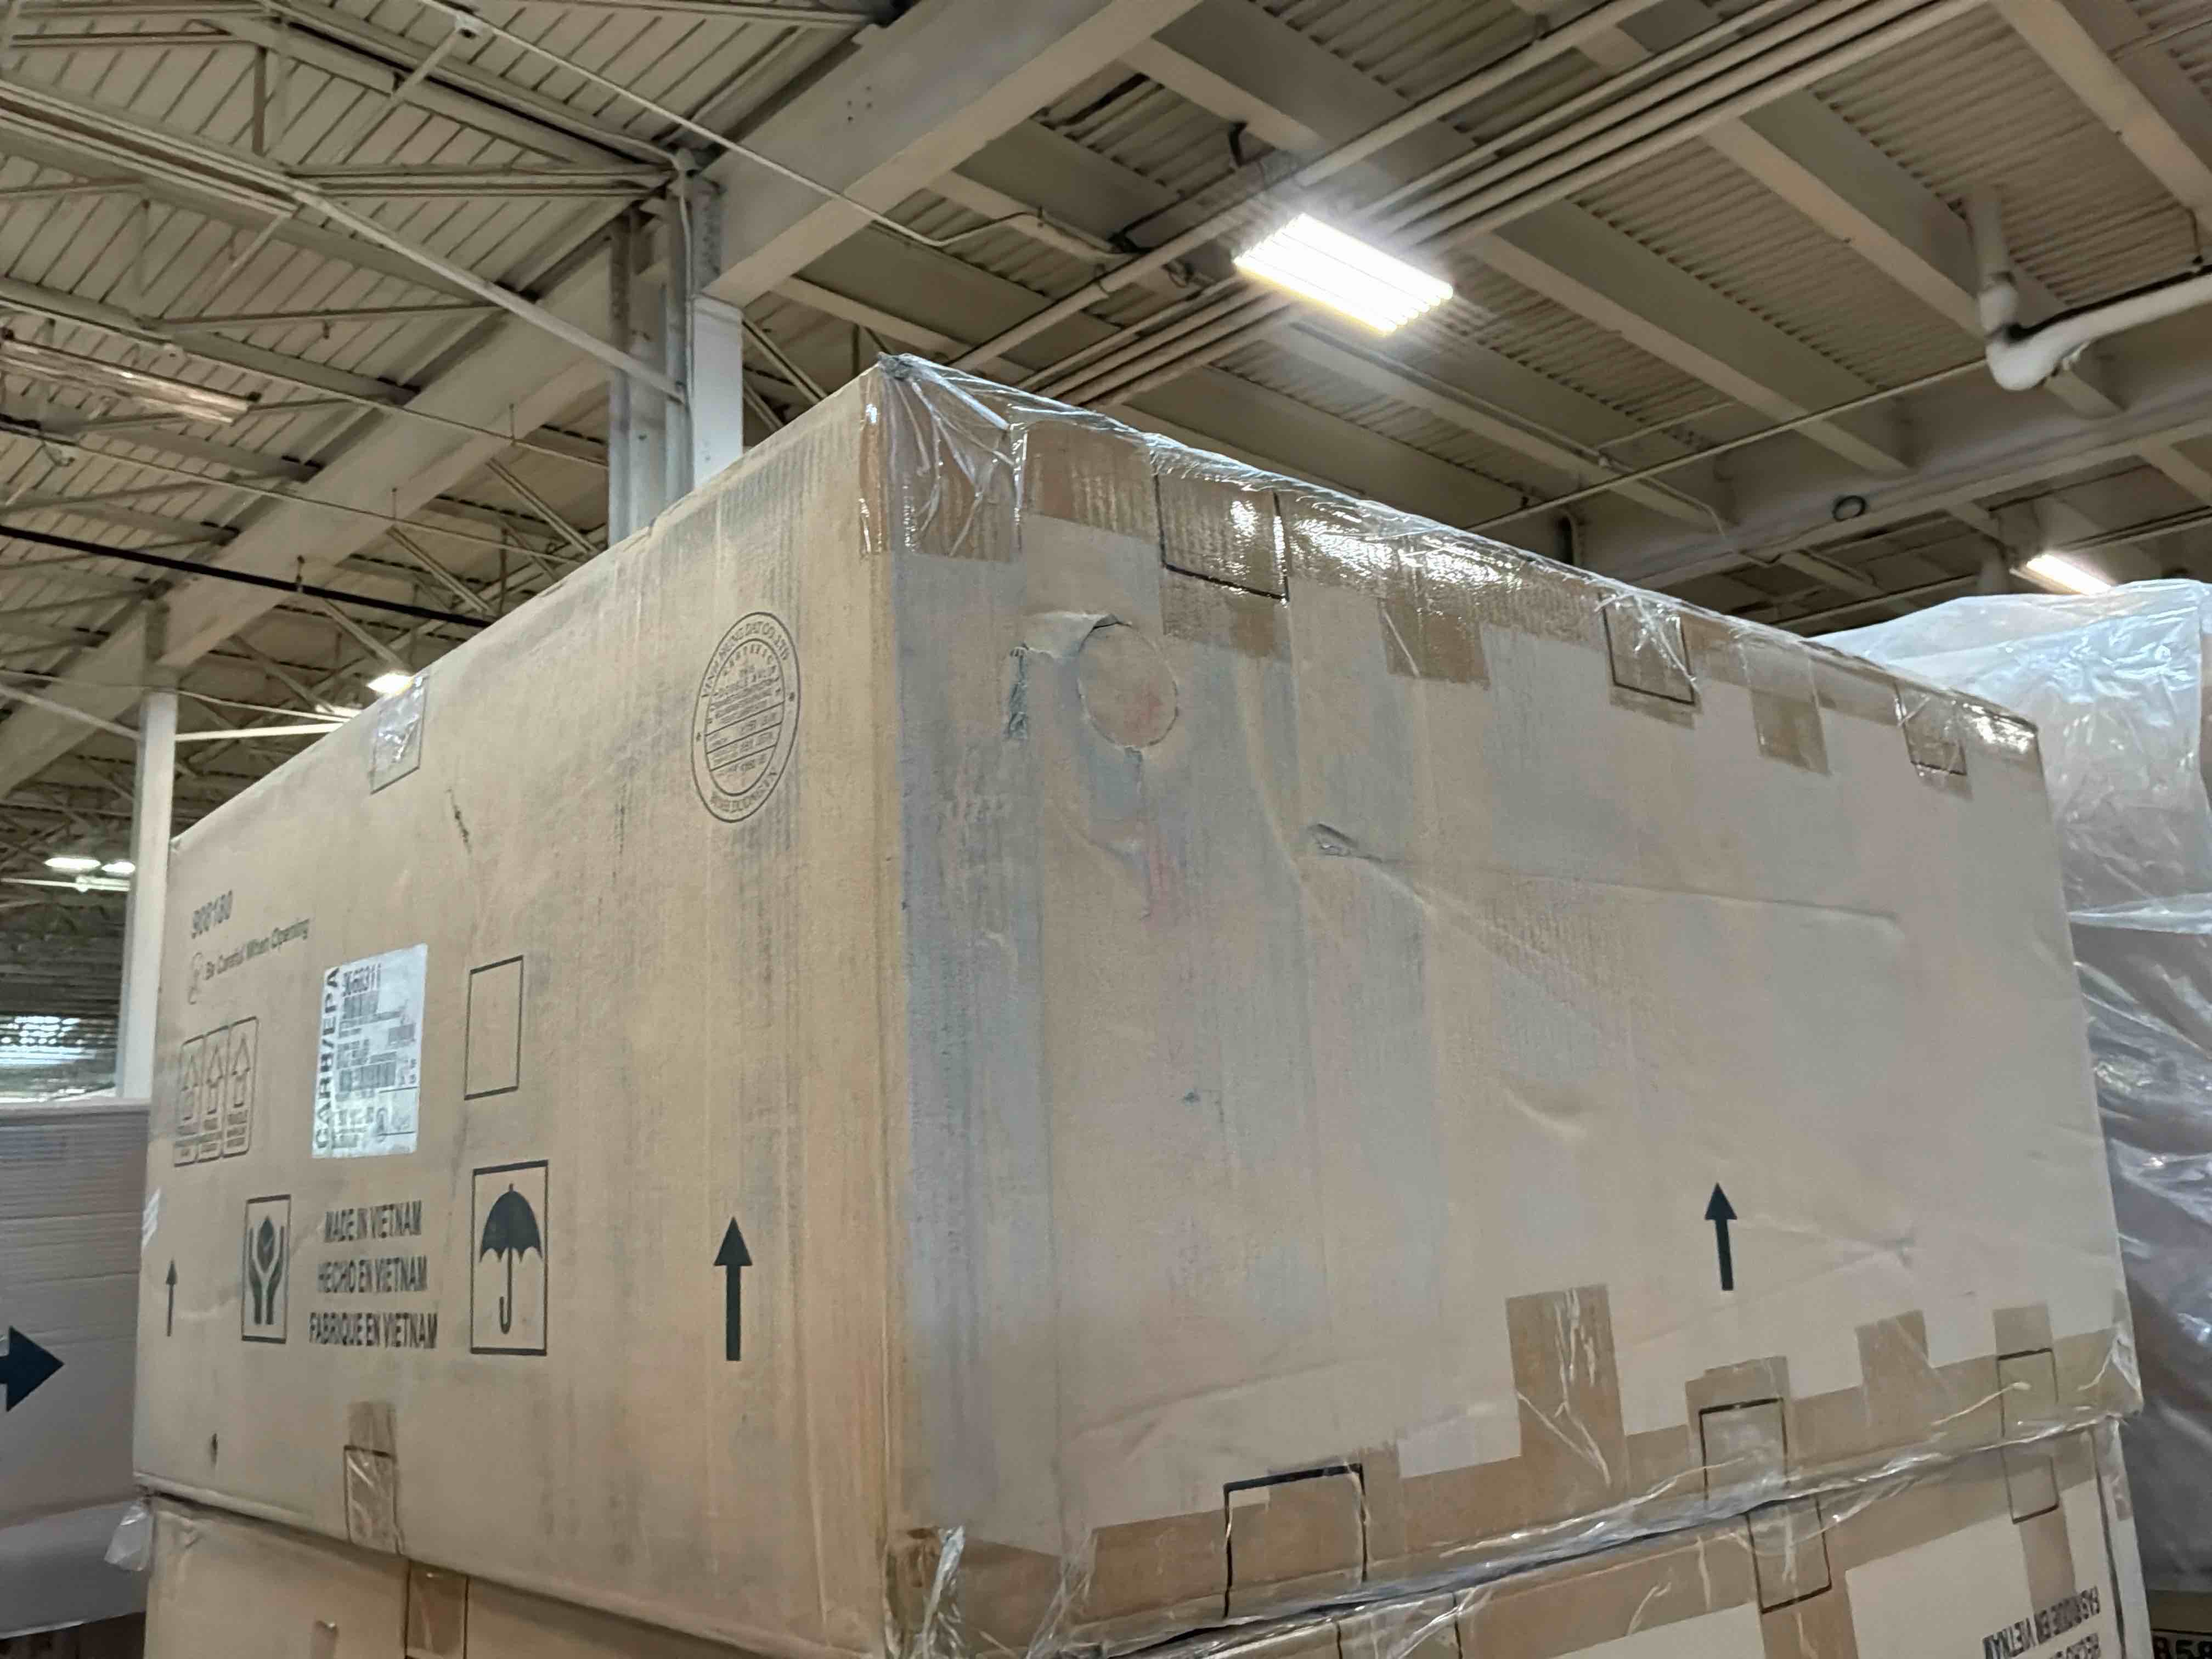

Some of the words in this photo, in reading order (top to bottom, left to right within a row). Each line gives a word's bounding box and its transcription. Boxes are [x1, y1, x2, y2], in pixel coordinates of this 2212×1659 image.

[324, 1207, 354, 1242] MADE
[370, 1200, 421, 1238] VIETNAM
[318, 1260, 356, 1293] HECHO
[358, 1259, 373, 1293] EN
[374, 1255, 427, 1293] VIETNAM
[309, 1312, 364, 1345] FABRIQUE
[365, 1312, 380, 1347] EN
[382, 1313, 438, 1349] VIETNAM
